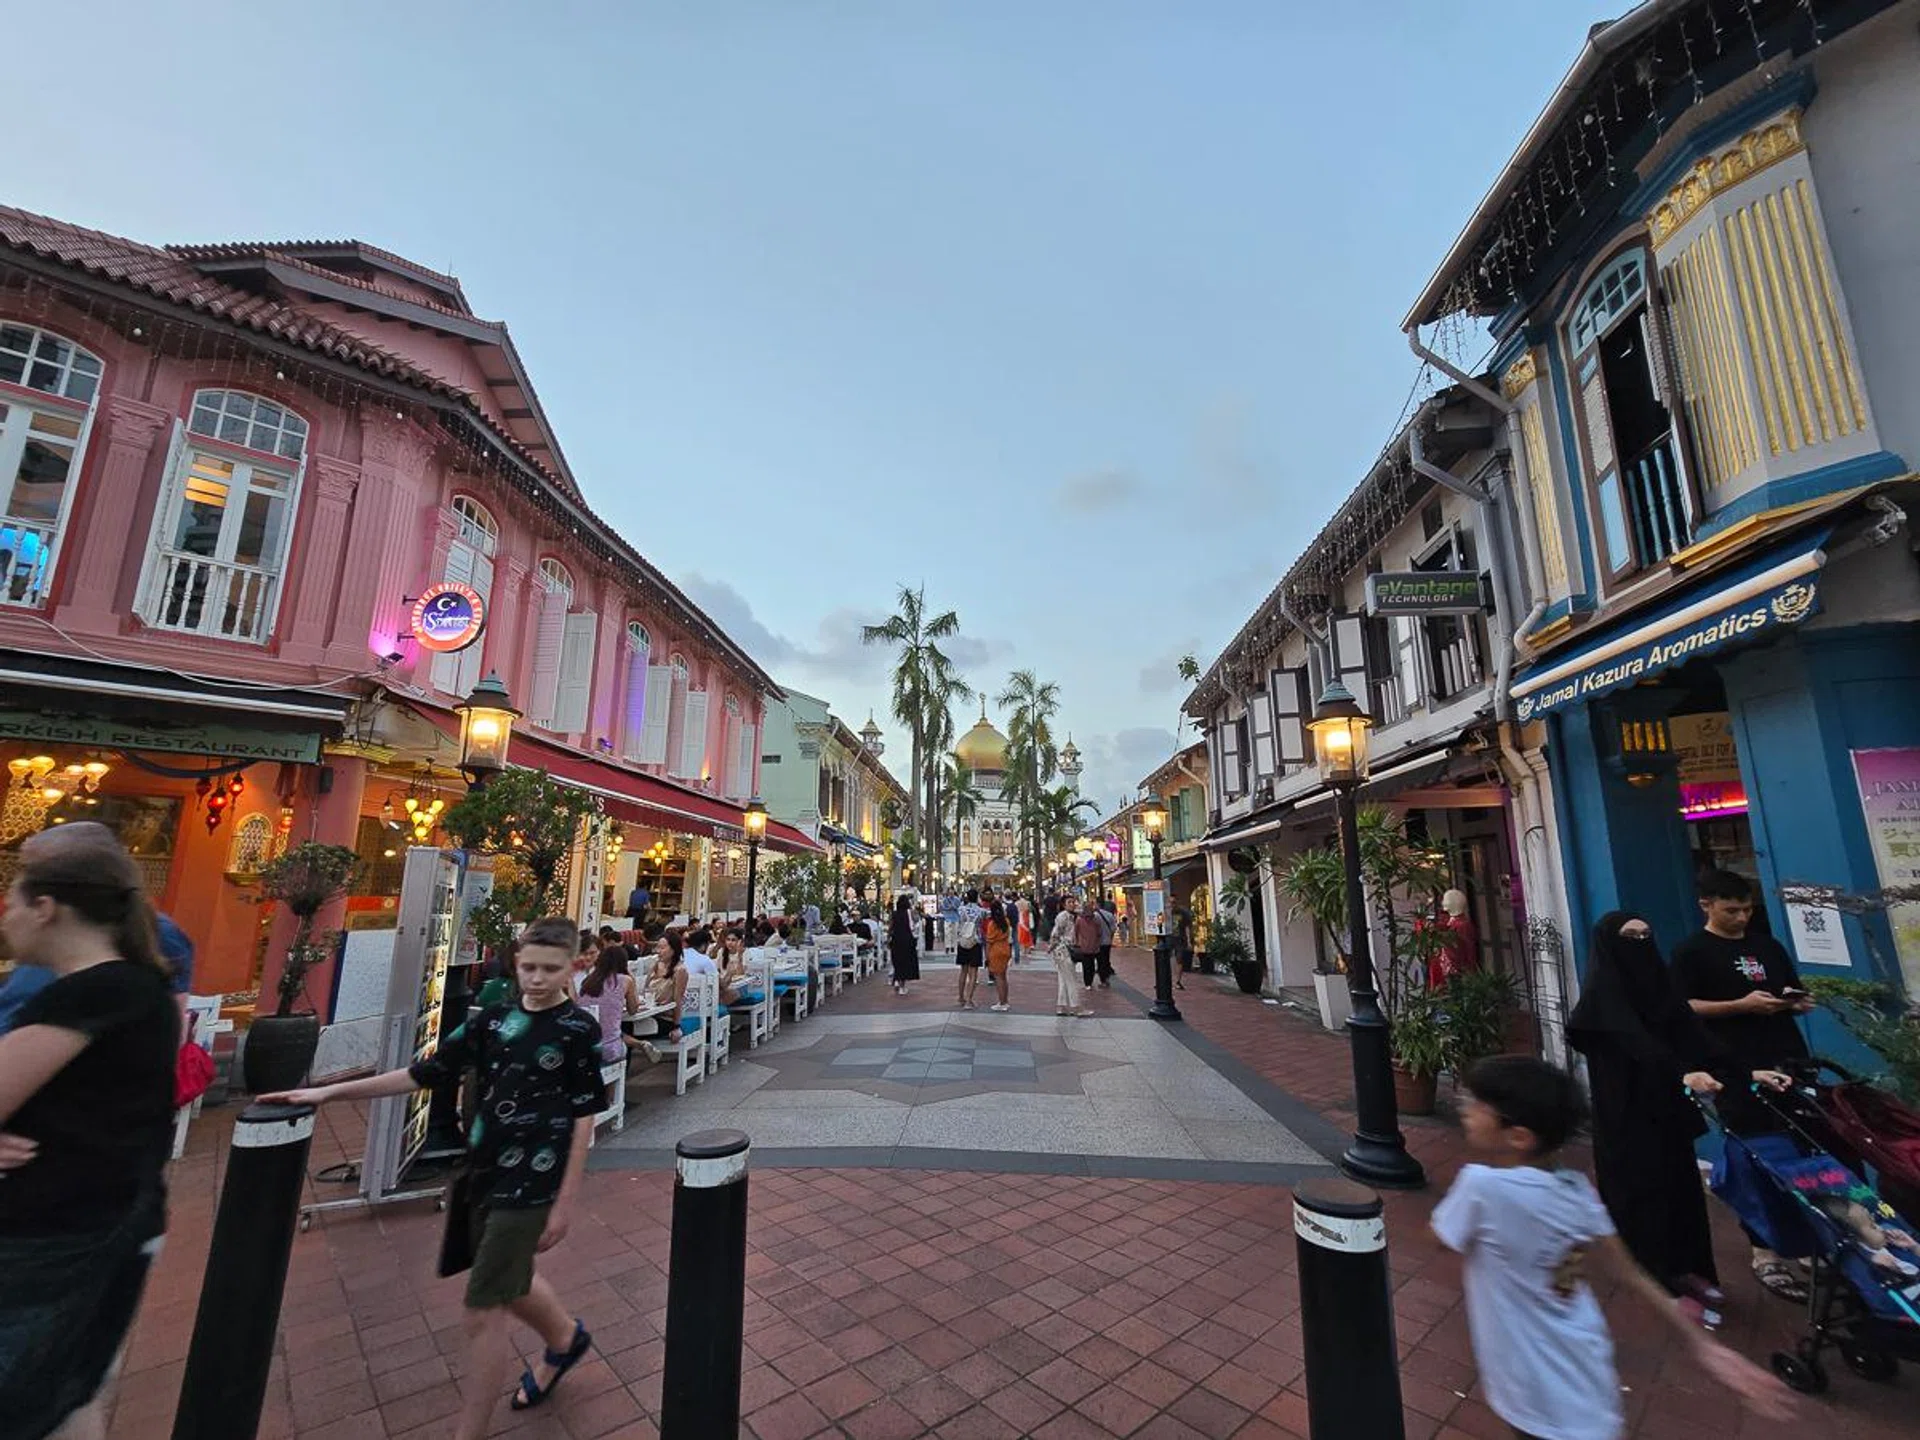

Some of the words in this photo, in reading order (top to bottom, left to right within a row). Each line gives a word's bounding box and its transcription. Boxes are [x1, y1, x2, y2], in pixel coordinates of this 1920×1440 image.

[1382, 594, 1455, 603] TECHNOLOGY
[1536, 678, 1579, 711] Jamal
[1582, 658, 1644, 693] Kazura
[1647, 608, 1767, 668] Aromatics
[112, 732, 306, 758] RESTAURANT
